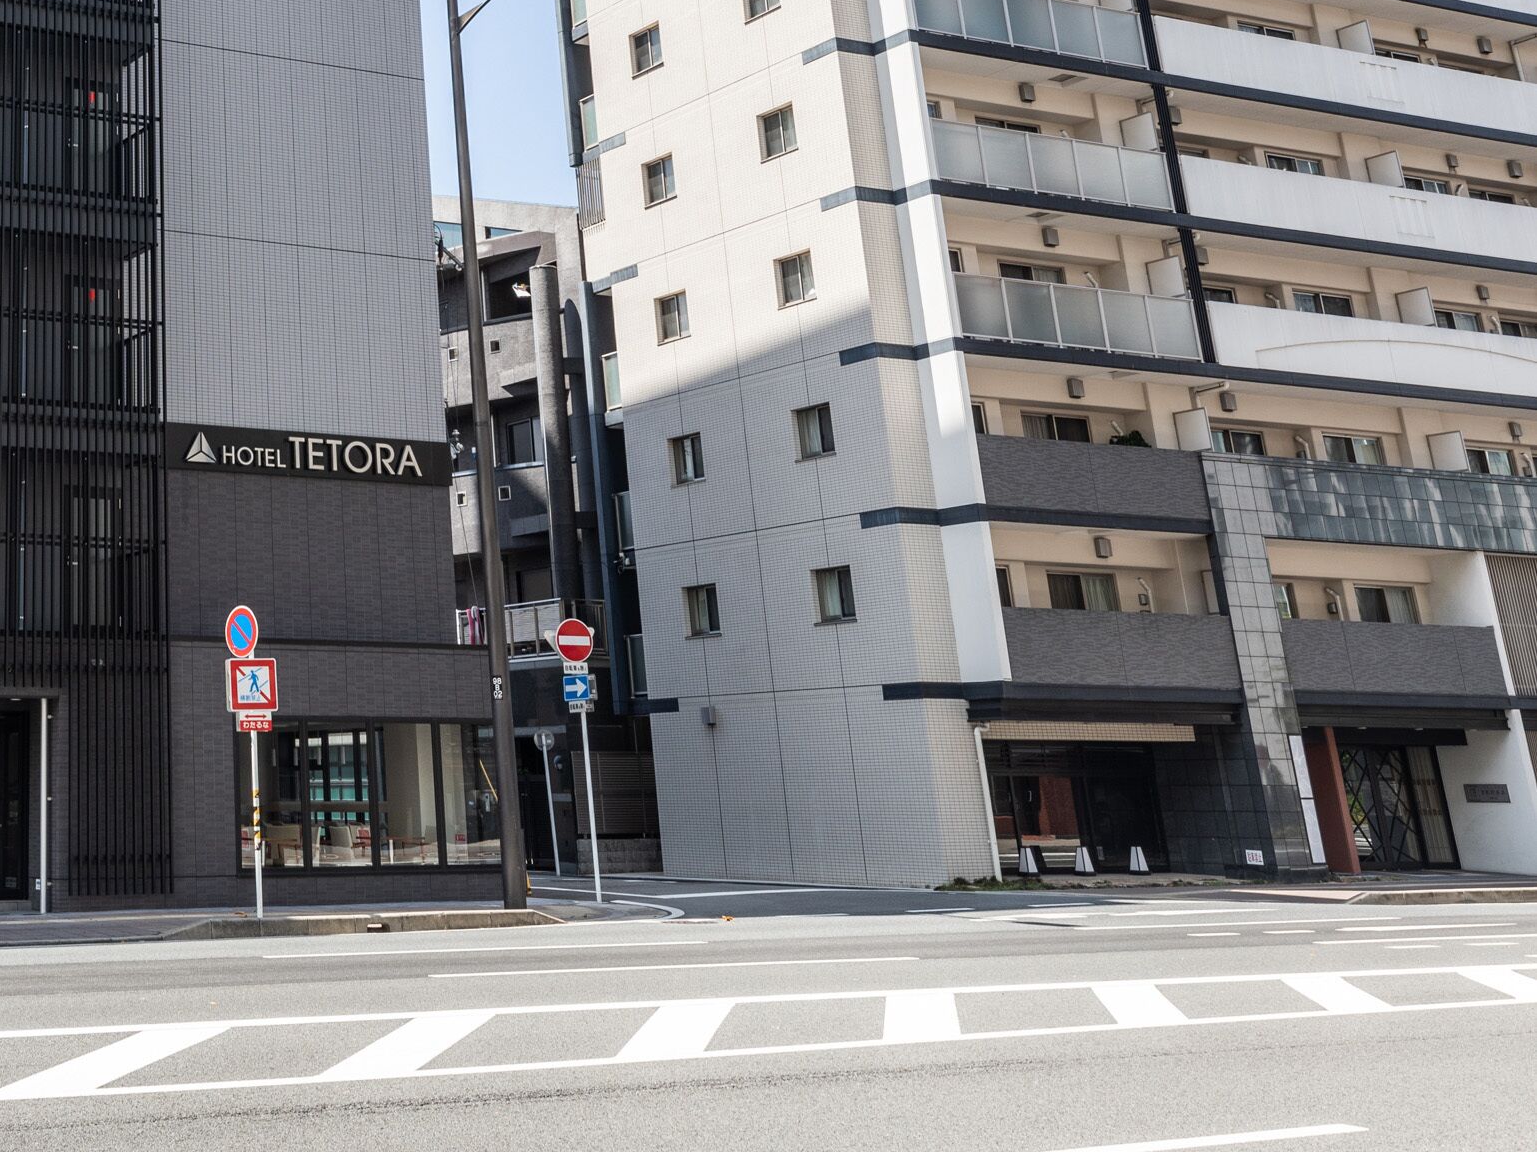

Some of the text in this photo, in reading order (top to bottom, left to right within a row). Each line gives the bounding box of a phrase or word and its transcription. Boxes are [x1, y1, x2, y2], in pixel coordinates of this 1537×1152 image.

[222, 436, 423, 477] HOTEL TETORA
[243, 721, 269, 729] わたるな
